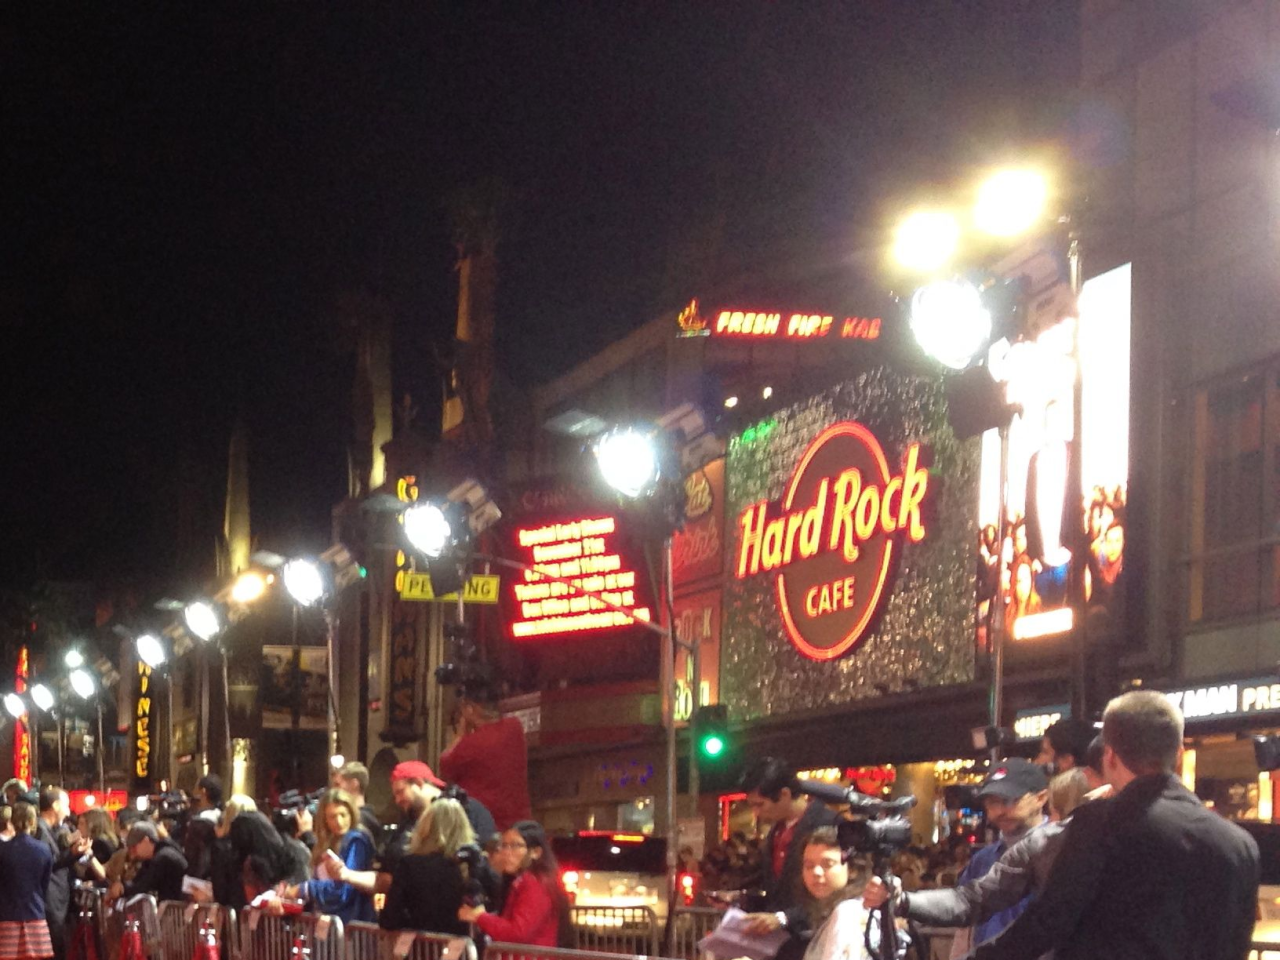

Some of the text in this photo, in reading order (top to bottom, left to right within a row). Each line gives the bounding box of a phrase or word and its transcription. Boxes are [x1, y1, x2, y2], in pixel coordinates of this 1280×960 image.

[716, 310, 781, 335] FRESH
[787, 313, 833, 337] FIRE
[735, 476, 830, 579] Hard
[828, 442, 929, 563] Rock
[806, 576, 855, 618] CAFE
